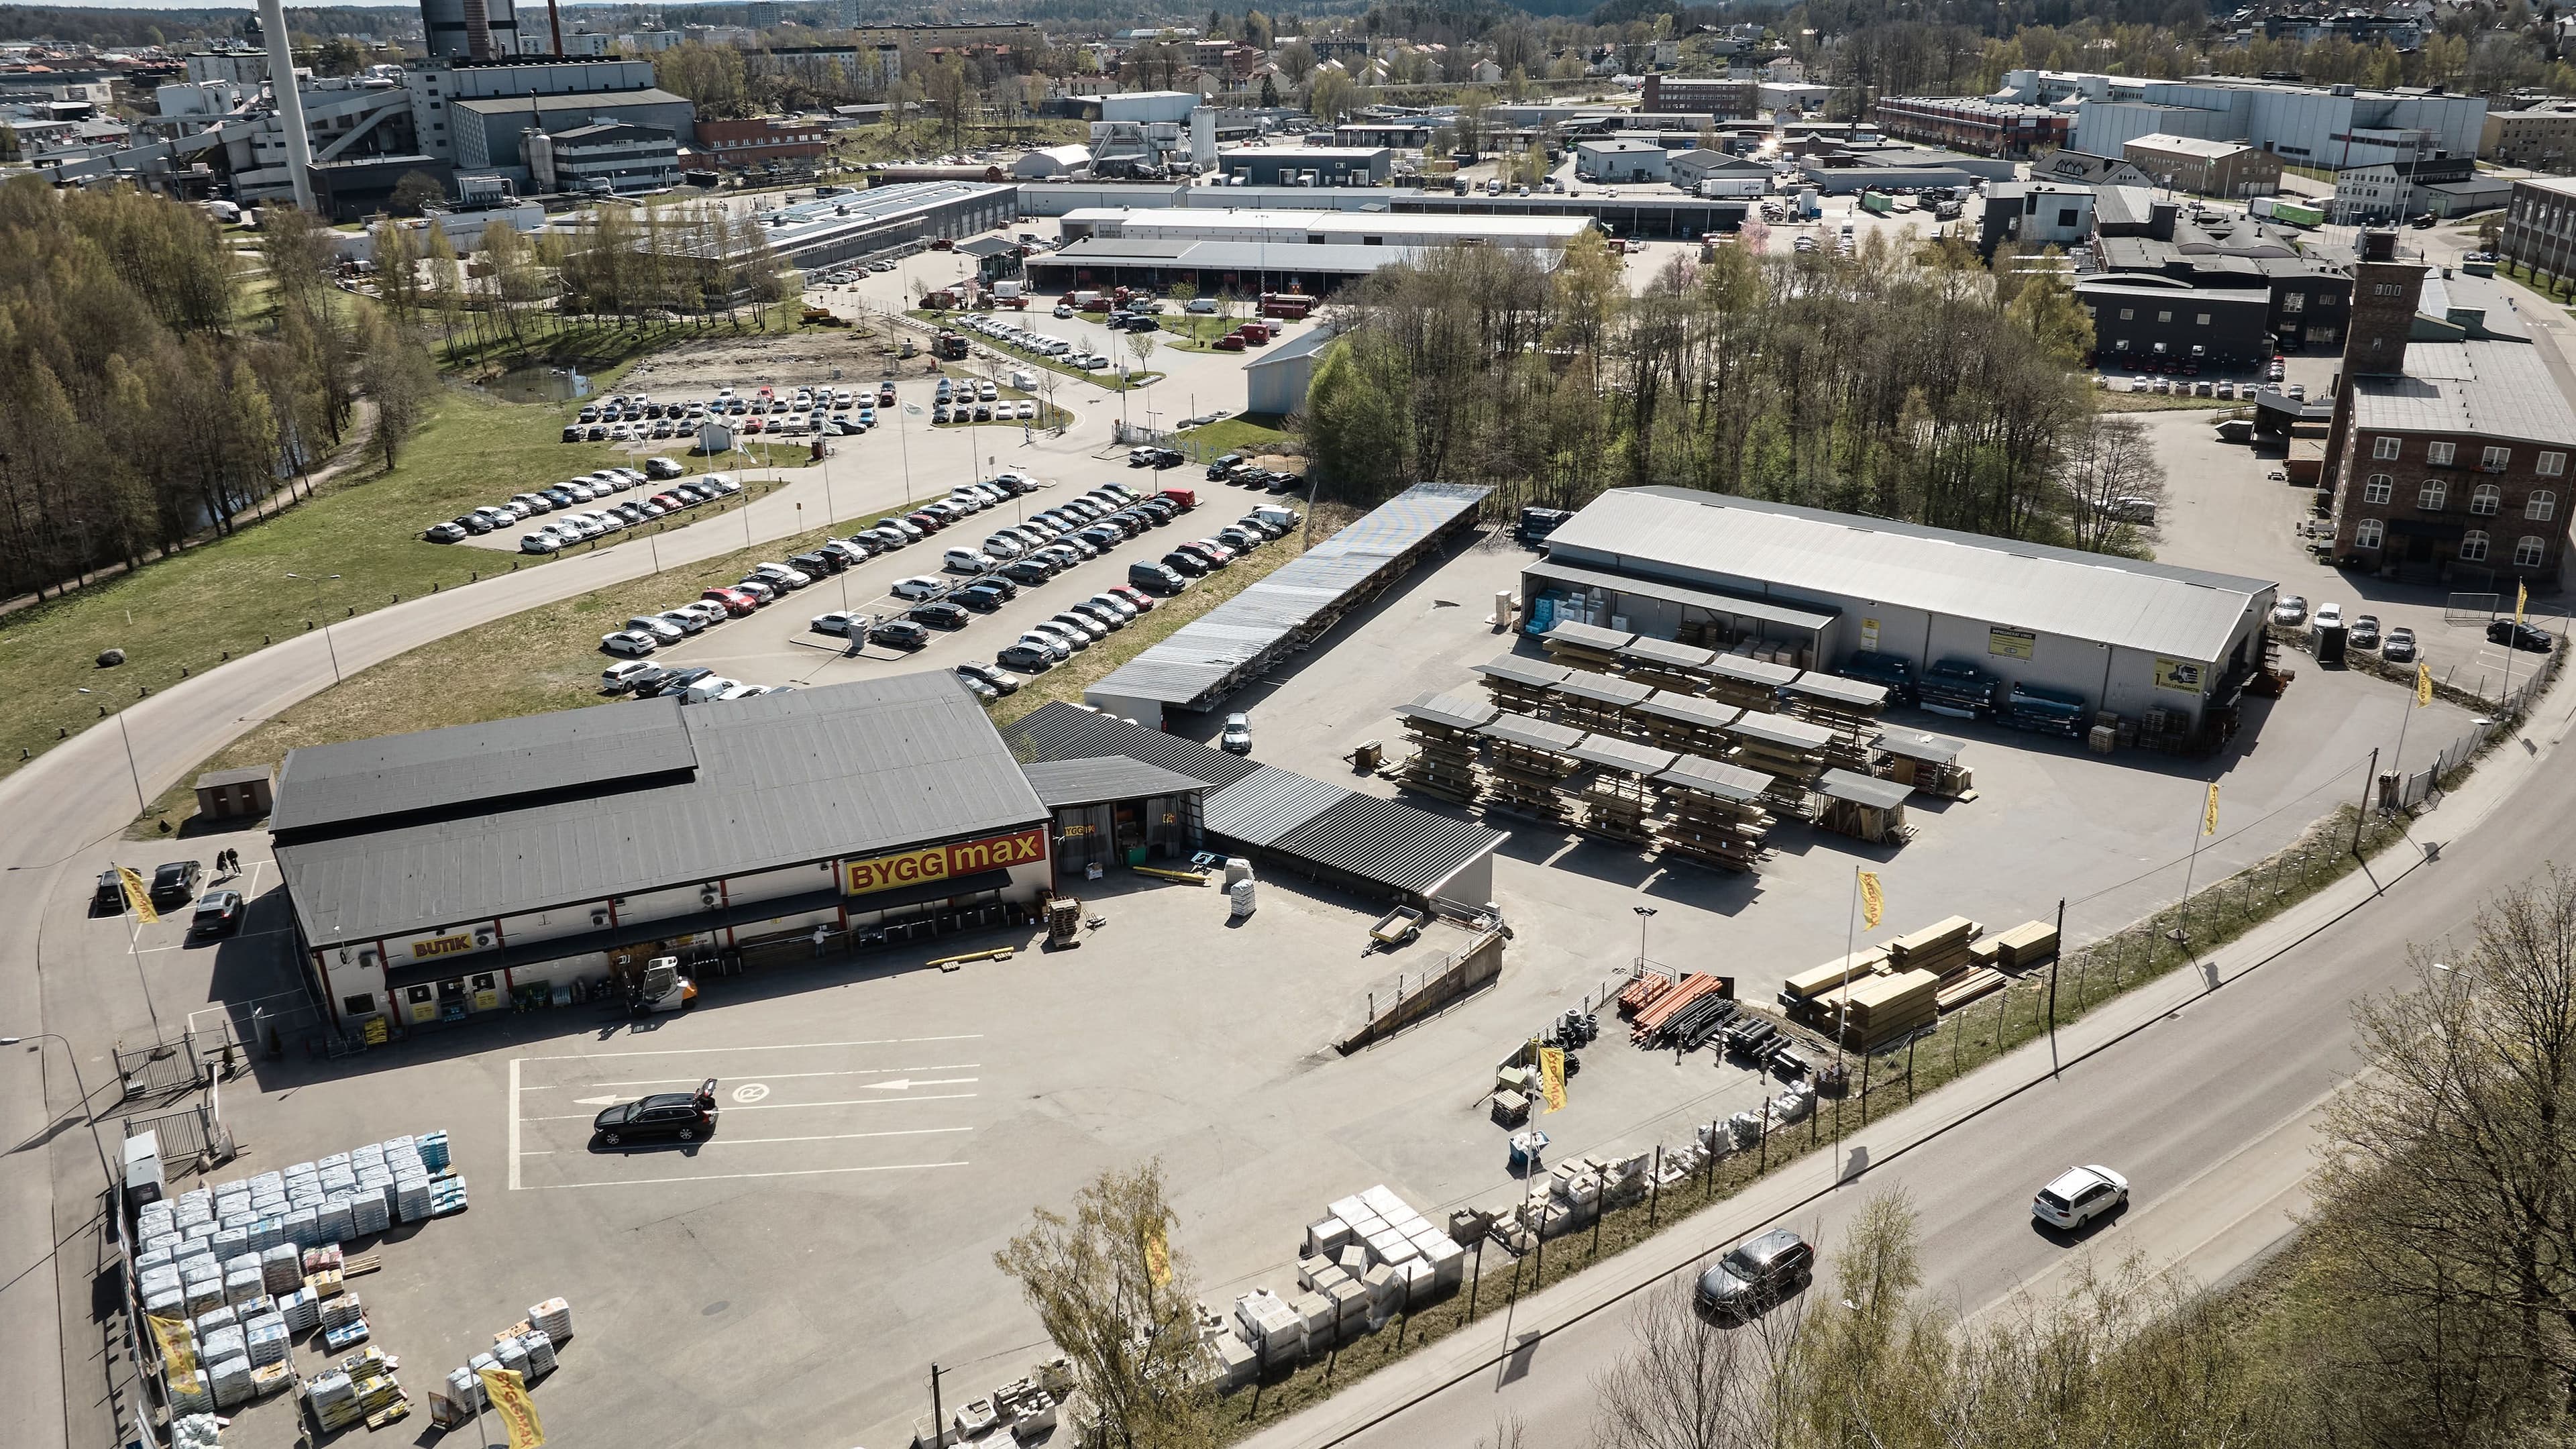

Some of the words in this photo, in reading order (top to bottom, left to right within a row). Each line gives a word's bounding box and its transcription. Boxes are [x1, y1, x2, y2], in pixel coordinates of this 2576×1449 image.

[851, 853, 944, 890] BYGG
[955, 835, 1037, 871] max
[415, 936, 470, 957] BUTIK
[494, 1372, 534, 1448] BYGGMAX
